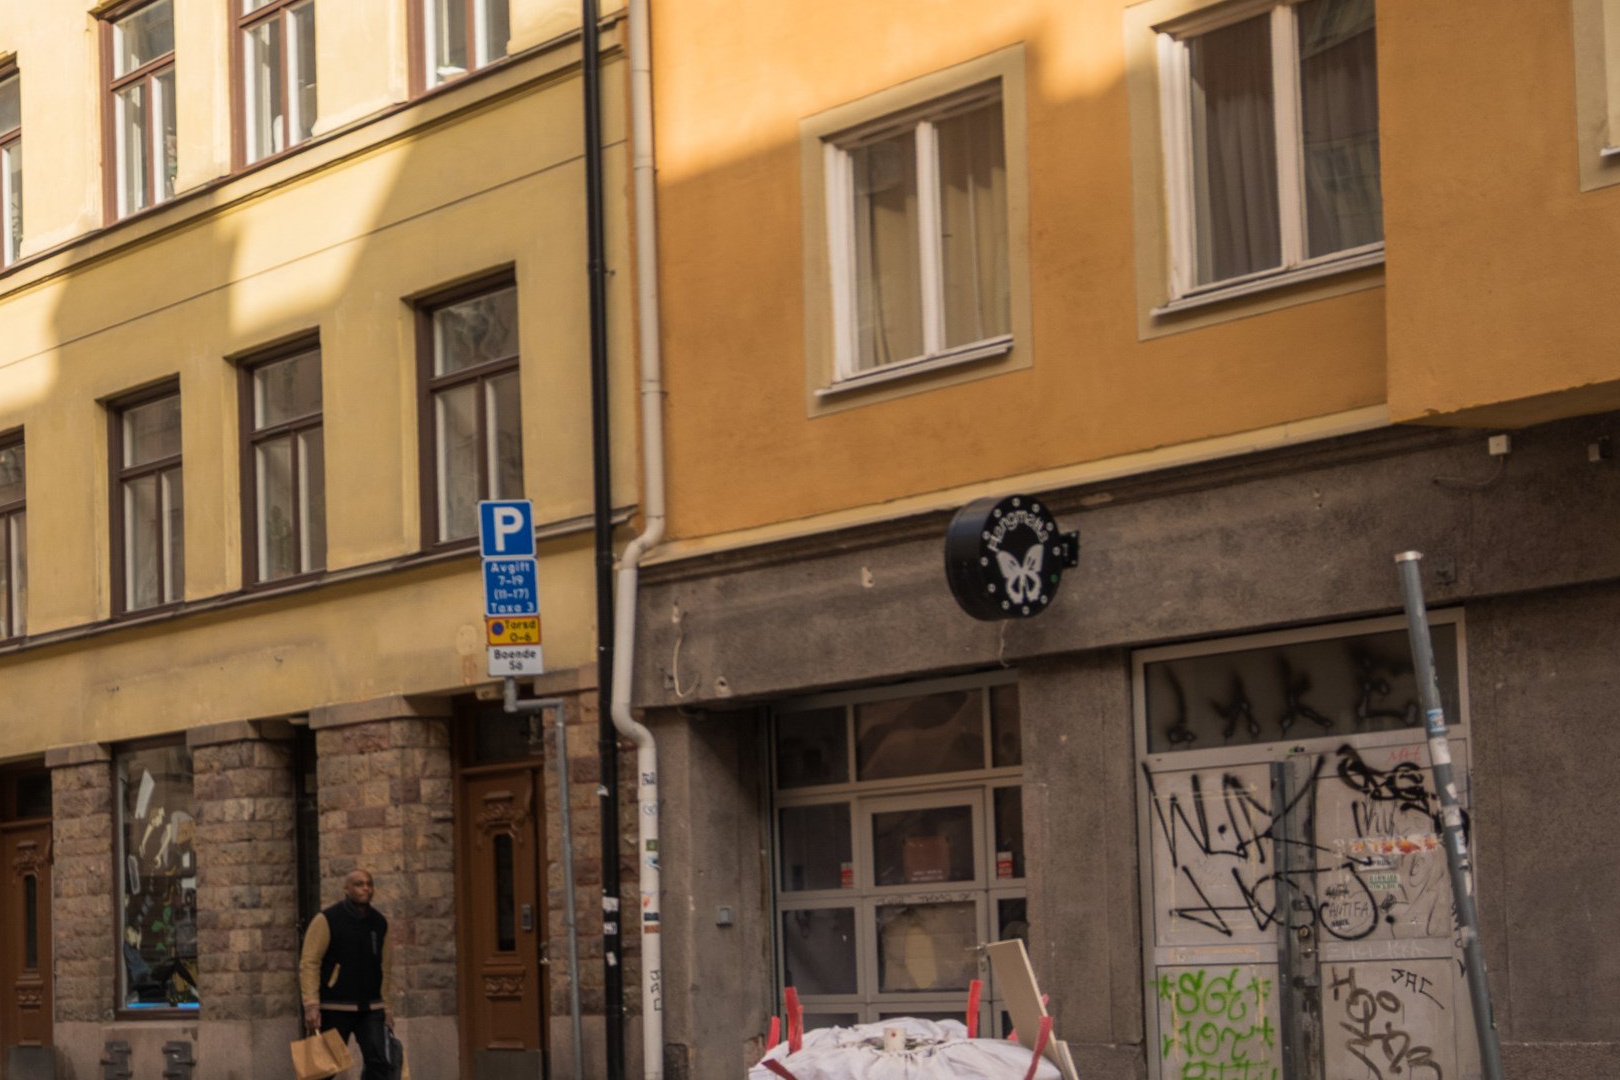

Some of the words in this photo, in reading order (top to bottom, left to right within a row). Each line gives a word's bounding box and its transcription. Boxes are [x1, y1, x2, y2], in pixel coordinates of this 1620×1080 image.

[493, 506, 524, 552] P
[490, 561, 530, 574] Avgift
[497, 575, 524, 586] 7-19
[493, 588, 530, 600] (11-17)
[490, 602, 522, 613] Taxa
[526, 601, 535, 613] 3
[494, 649, 536, 660] Boende
